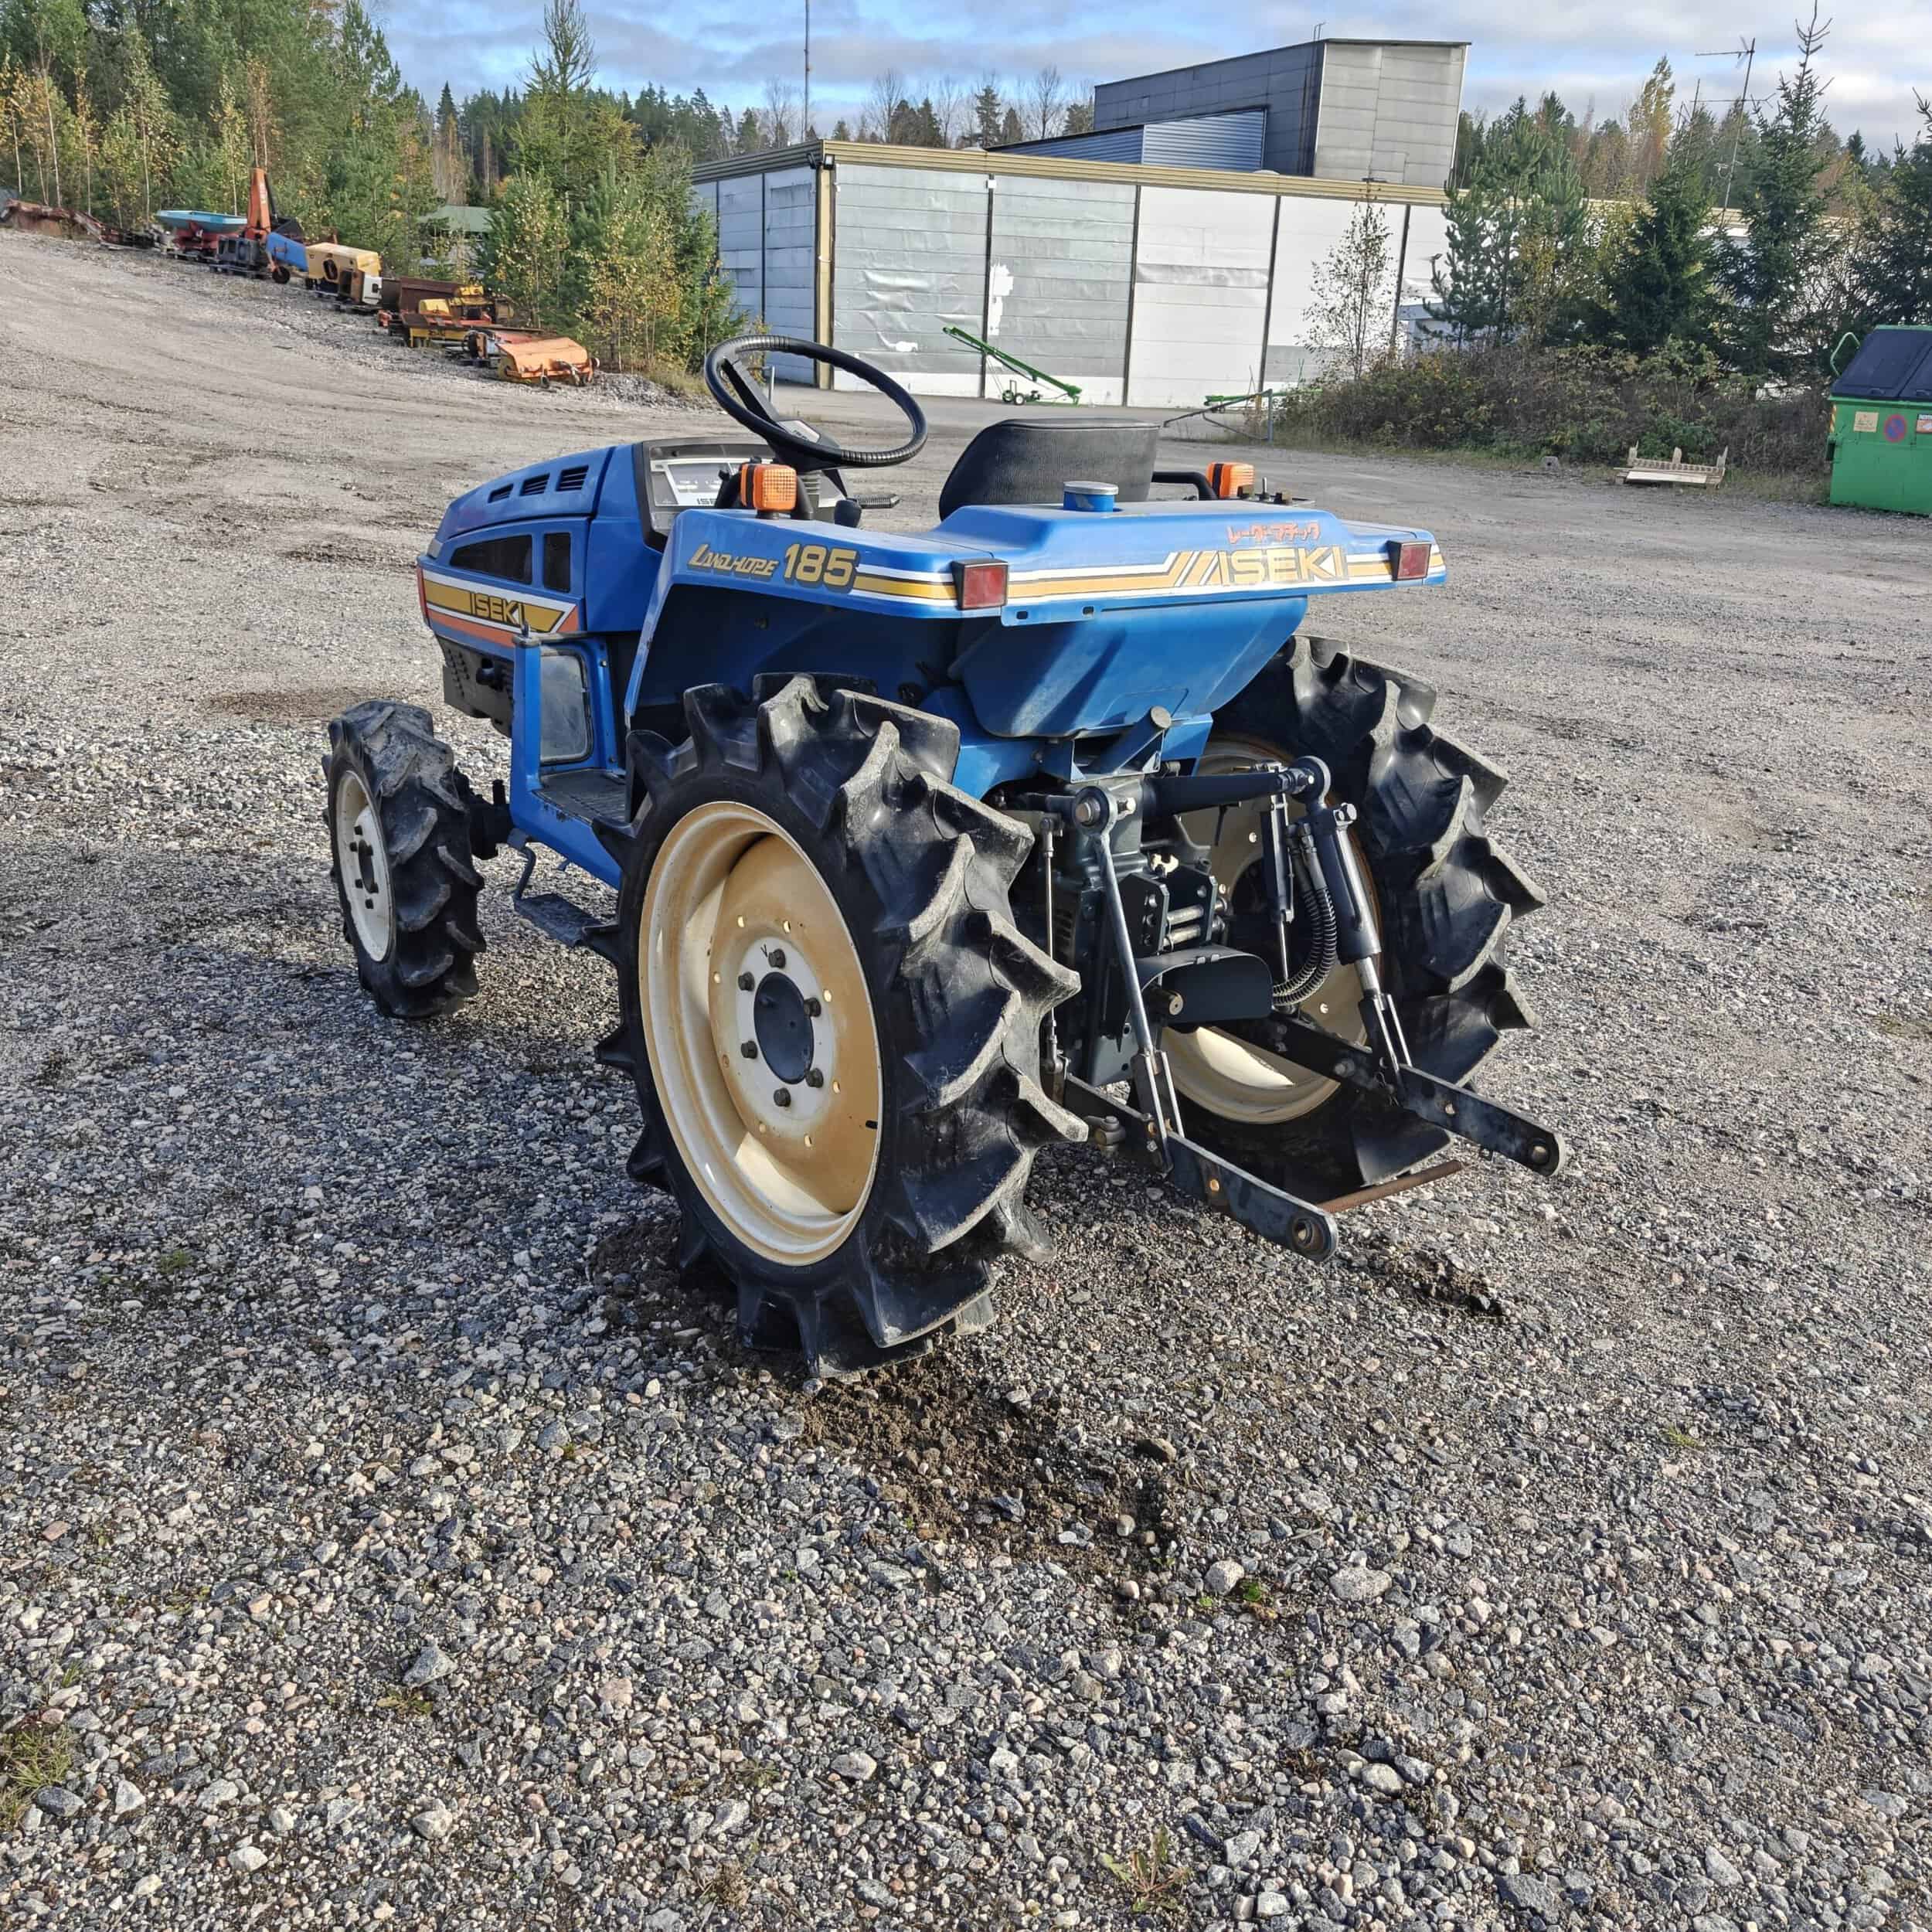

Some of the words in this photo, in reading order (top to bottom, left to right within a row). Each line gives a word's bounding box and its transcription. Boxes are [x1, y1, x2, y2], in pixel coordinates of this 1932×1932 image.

[783, 543, 859, 587] 185
[1219, 545, 1348, 586] ISEKI
[470, 592, 526, 628] ISEKI
